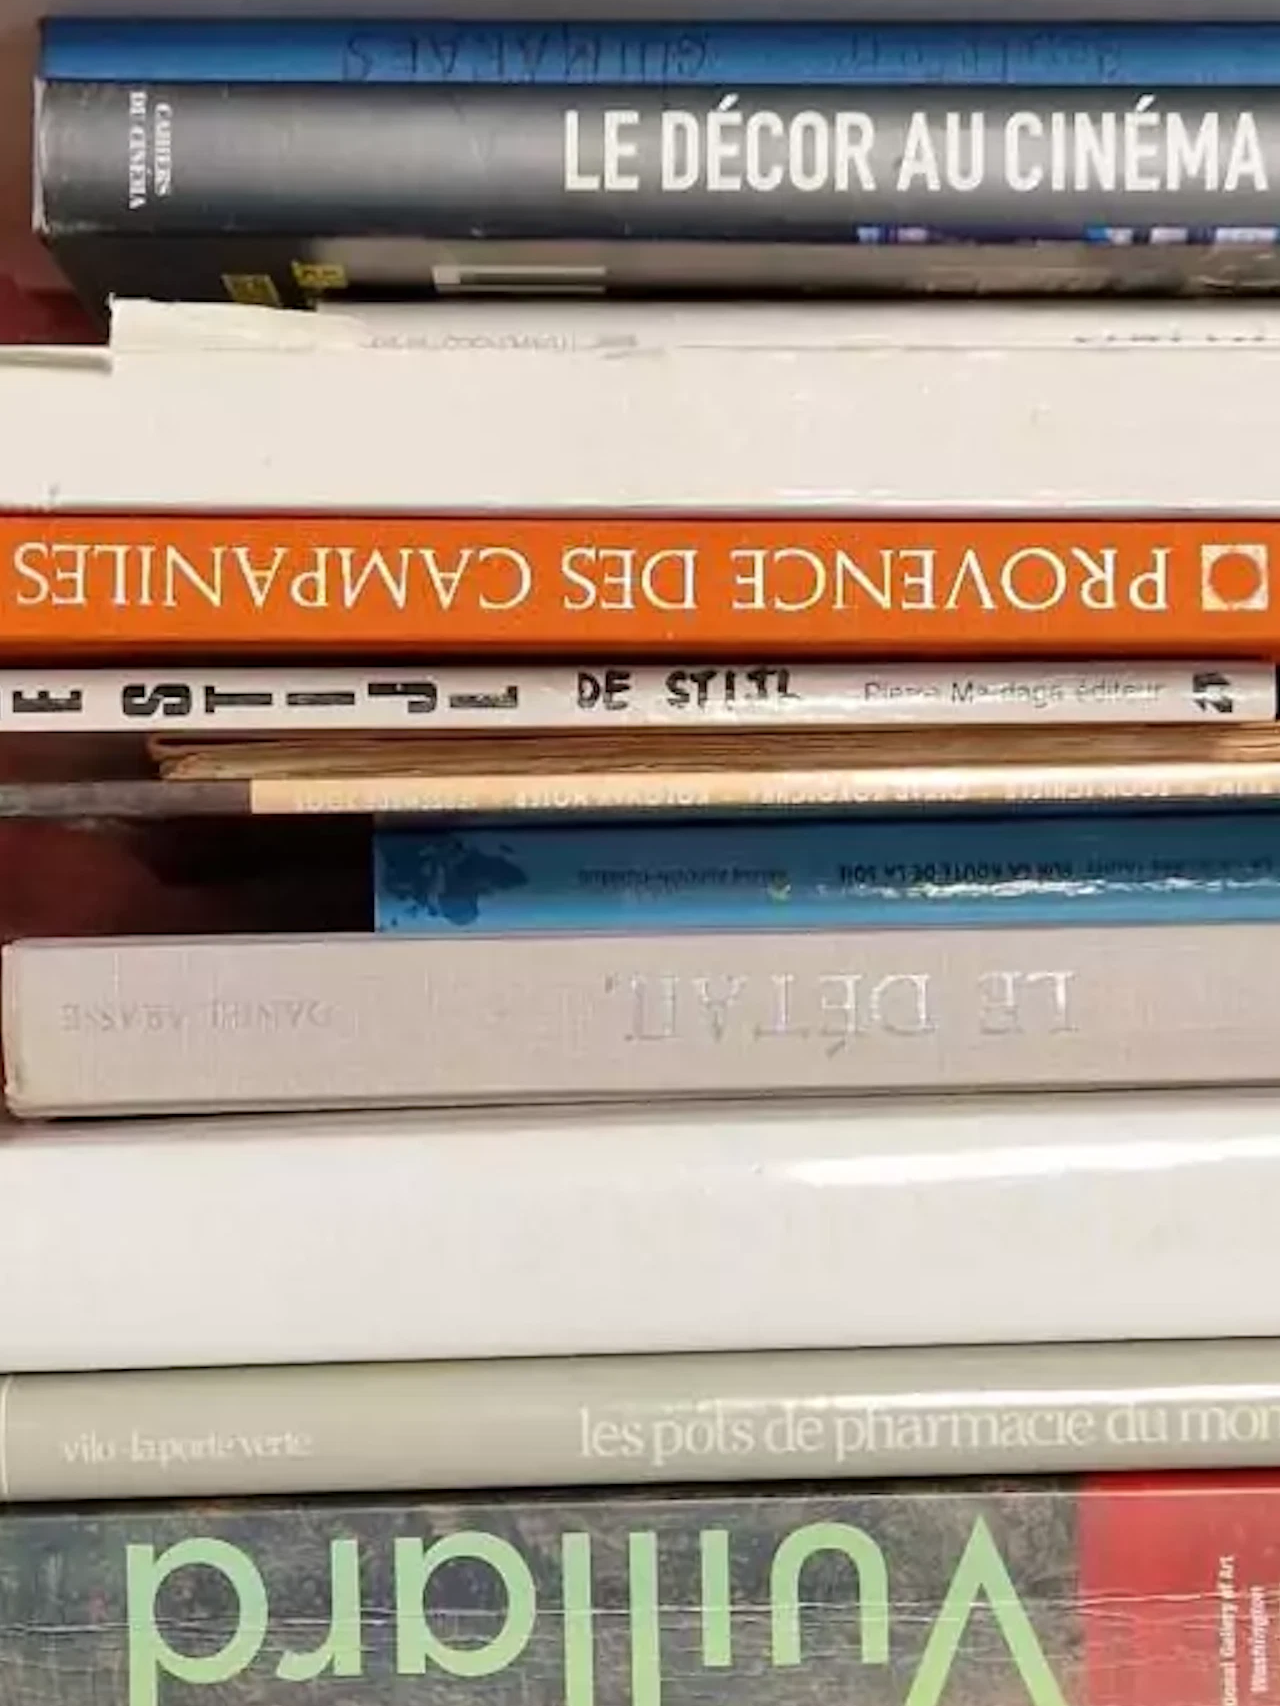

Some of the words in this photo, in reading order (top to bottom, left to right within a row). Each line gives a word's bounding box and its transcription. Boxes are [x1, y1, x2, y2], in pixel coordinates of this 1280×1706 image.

[153, 102, 174, 198] CAHIERS
[564, 110, 640, 192] LE
[660, 94, 875, 192] DÉCOR
[897, 110, 984, 192] AU
[1004, 95, 1270, 192] CINÉMA
[12, 541, 533, 611] CAMPANILES
[560, 546, 696, 612] DES
[729, 544, 1171, 613] PROVENCE
[577, 670, 632, 711] DE
[602, 969, 939, 1059] DÉTAIL
[977, 969, 1082, 1038] LE
[579, 1405, 645, 1459] les
[651, 1399, 756, 1468] pots
[763, 1398, 825, 1455] de
[834, 1400, 1095, 1465] pharmacie
[1105, 1398, 1168, 1445] du
